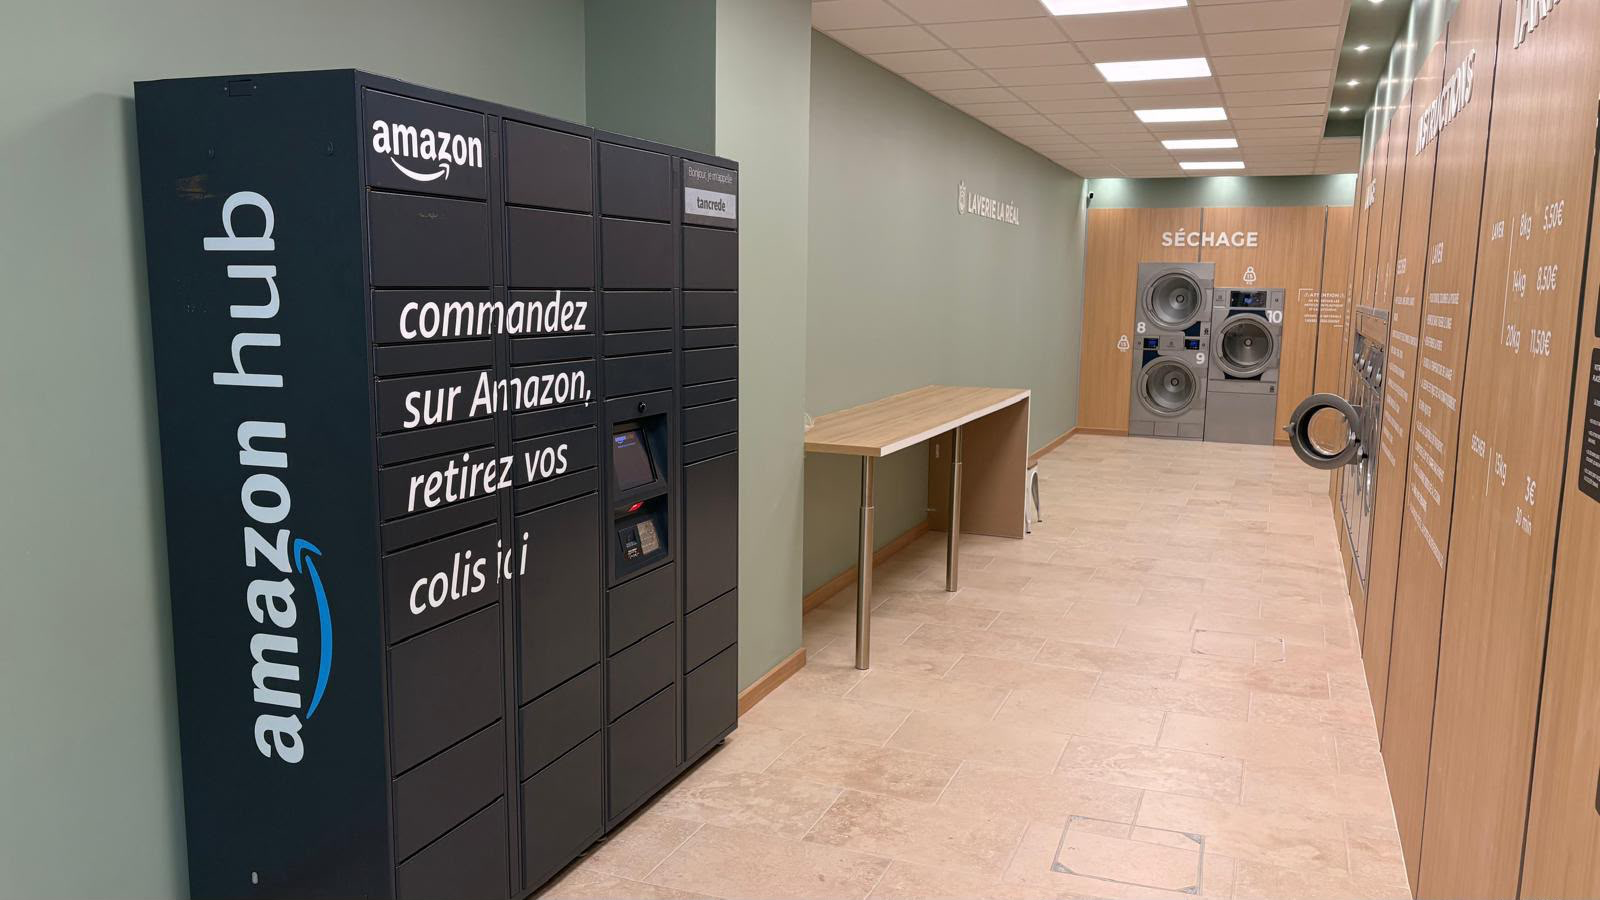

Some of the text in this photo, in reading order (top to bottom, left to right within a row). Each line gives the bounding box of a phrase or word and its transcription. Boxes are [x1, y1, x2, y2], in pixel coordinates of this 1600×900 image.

[372, 119, 483, 168] amazon
[696, 196, 726, 212] tancrede
[967, 191, 1020, 225] LAVERIE LA RÉAL
[1519, 213, 1532, 241] 8kg
[1543, 200, 1565, 235] 5,50€
[1161, 228, 1259, 248] SÉCHAGE
[1536, 264, 1559, 295] 8,50€
[400, 291, 587, 339] commandez
[1137, 321, 1146, 334] 8
[1267, 310, 1283, 323] 10
[1505, 324, 1521, 354] 20kg
[1196, 352, 1205, 365] 9
[403, 369, 592, 429] sur Amazon,
[203, 190, 305, 765] amazon hub
[408, 443, 569, 513] retirez vos
[409, 531, 530, 616] colis ici
